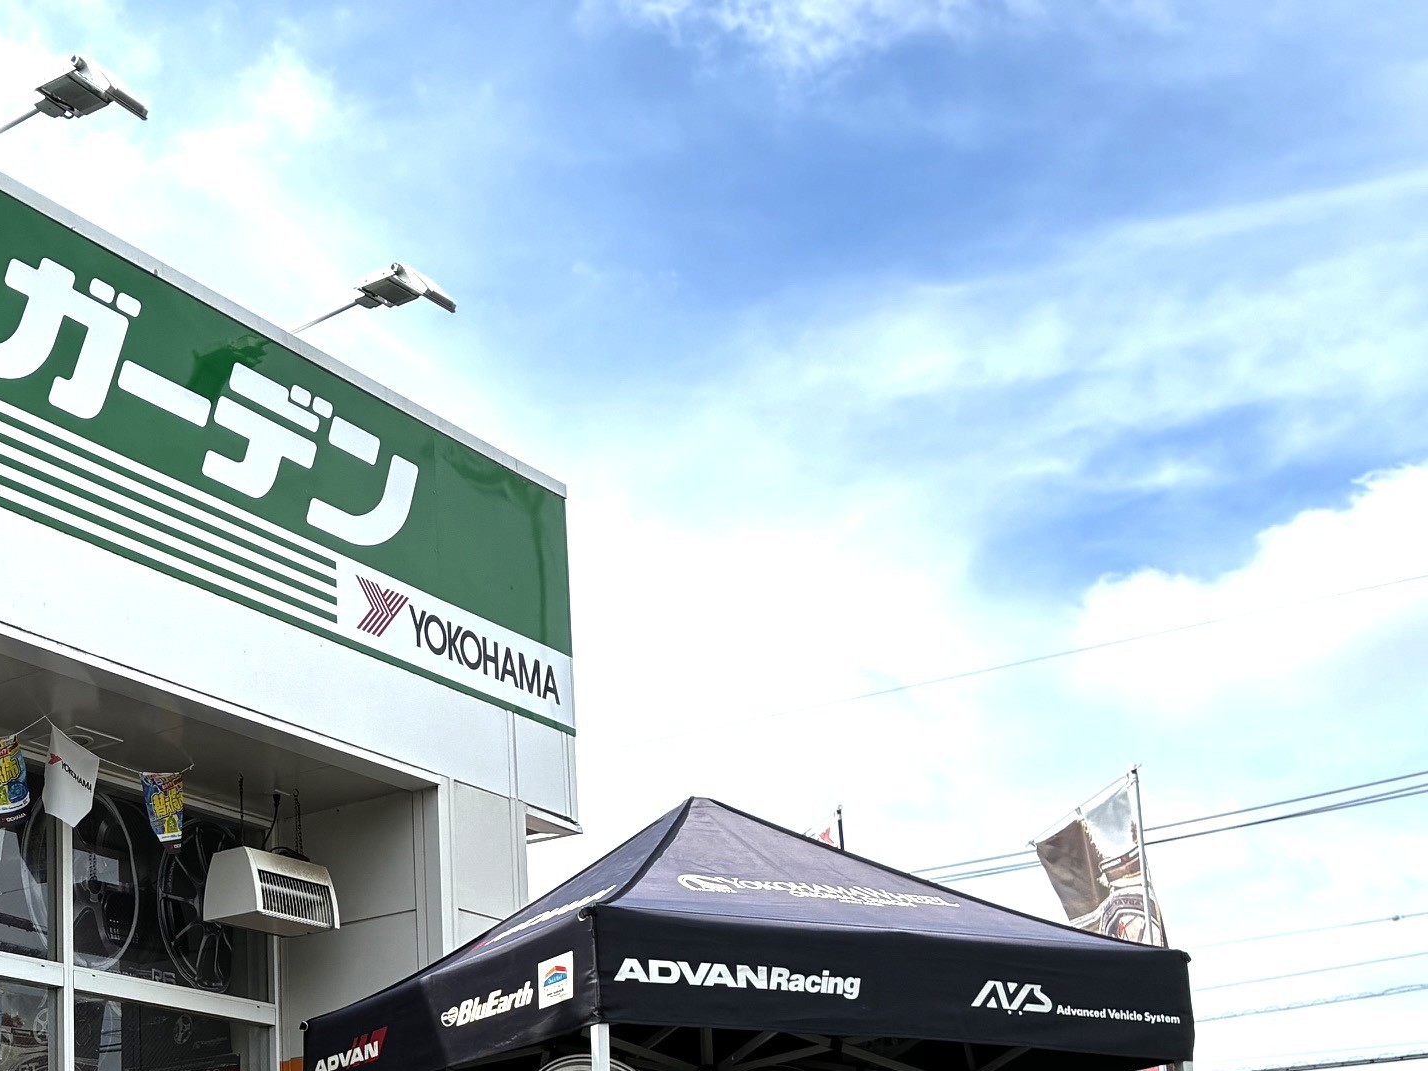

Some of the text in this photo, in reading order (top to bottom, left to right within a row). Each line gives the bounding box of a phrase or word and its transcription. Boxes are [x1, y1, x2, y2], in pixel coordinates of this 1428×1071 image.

[408, 603, 561, 705] YOKOHAMA
[61, 761, 92, 793] YOKOHAMA
[458, 981, 532, 1026] BluEarth
[1056, 1004, 1105, 1020] Advanced
[1107, 1008, 1143, 1022] Vehicle
[1144, 1011, 1180, 1024] System
